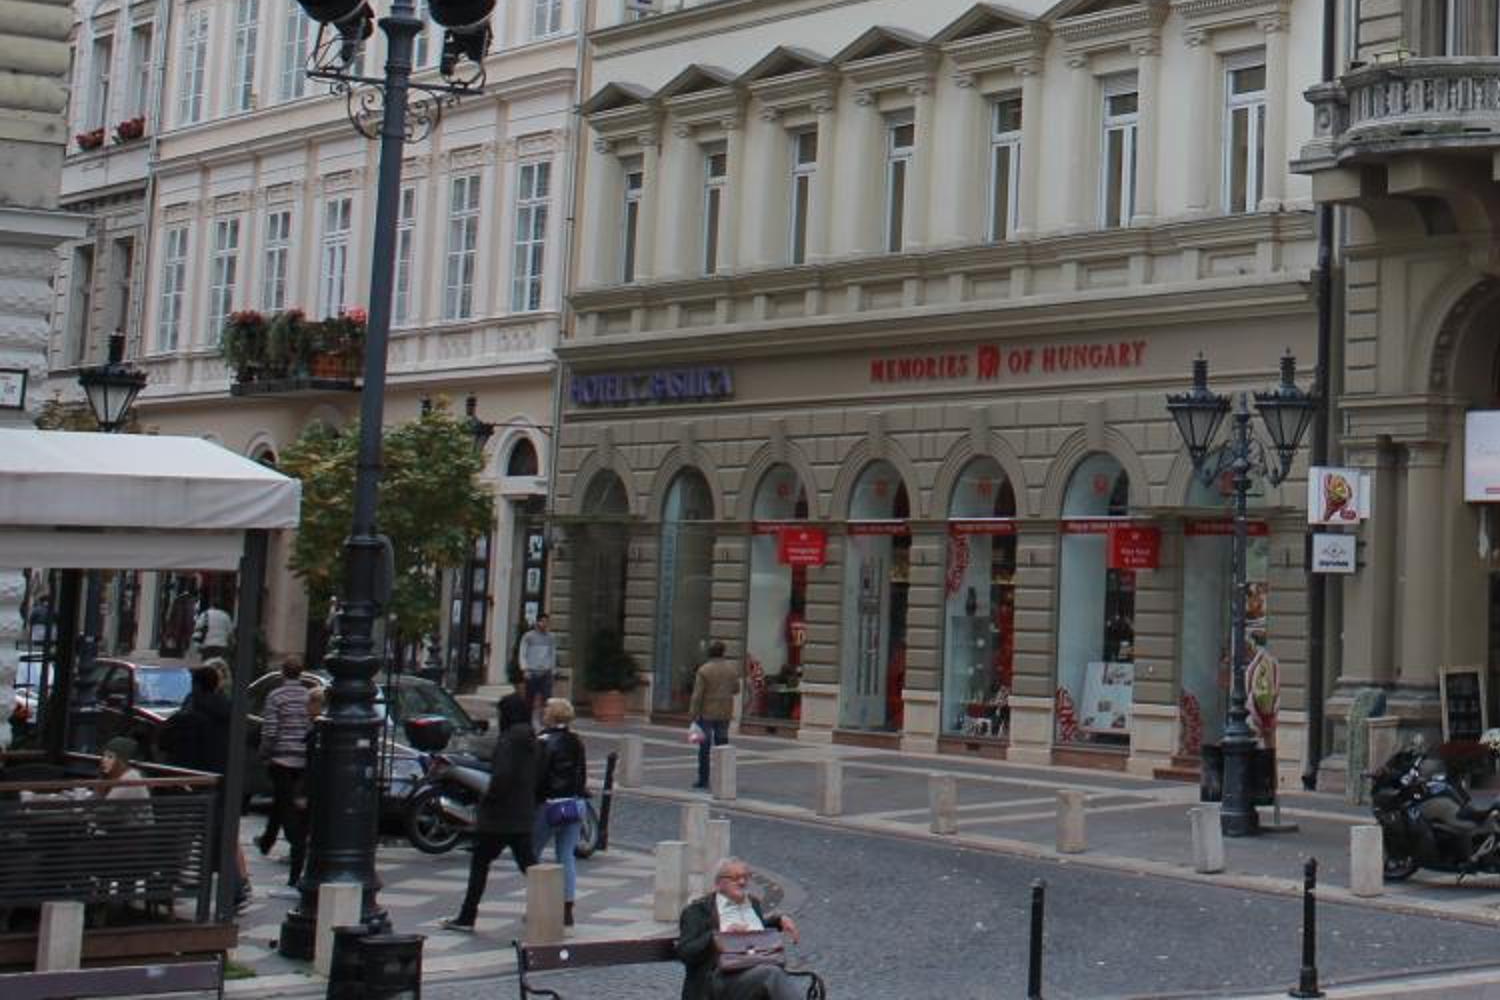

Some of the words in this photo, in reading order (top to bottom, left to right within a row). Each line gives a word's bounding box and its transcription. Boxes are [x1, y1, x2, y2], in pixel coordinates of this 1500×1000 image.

[870, 355, 969, 383] MEMORIES
[1007, 350, 1033, 374] OF
[1041, 340, 1147, 373] HUNGARY
